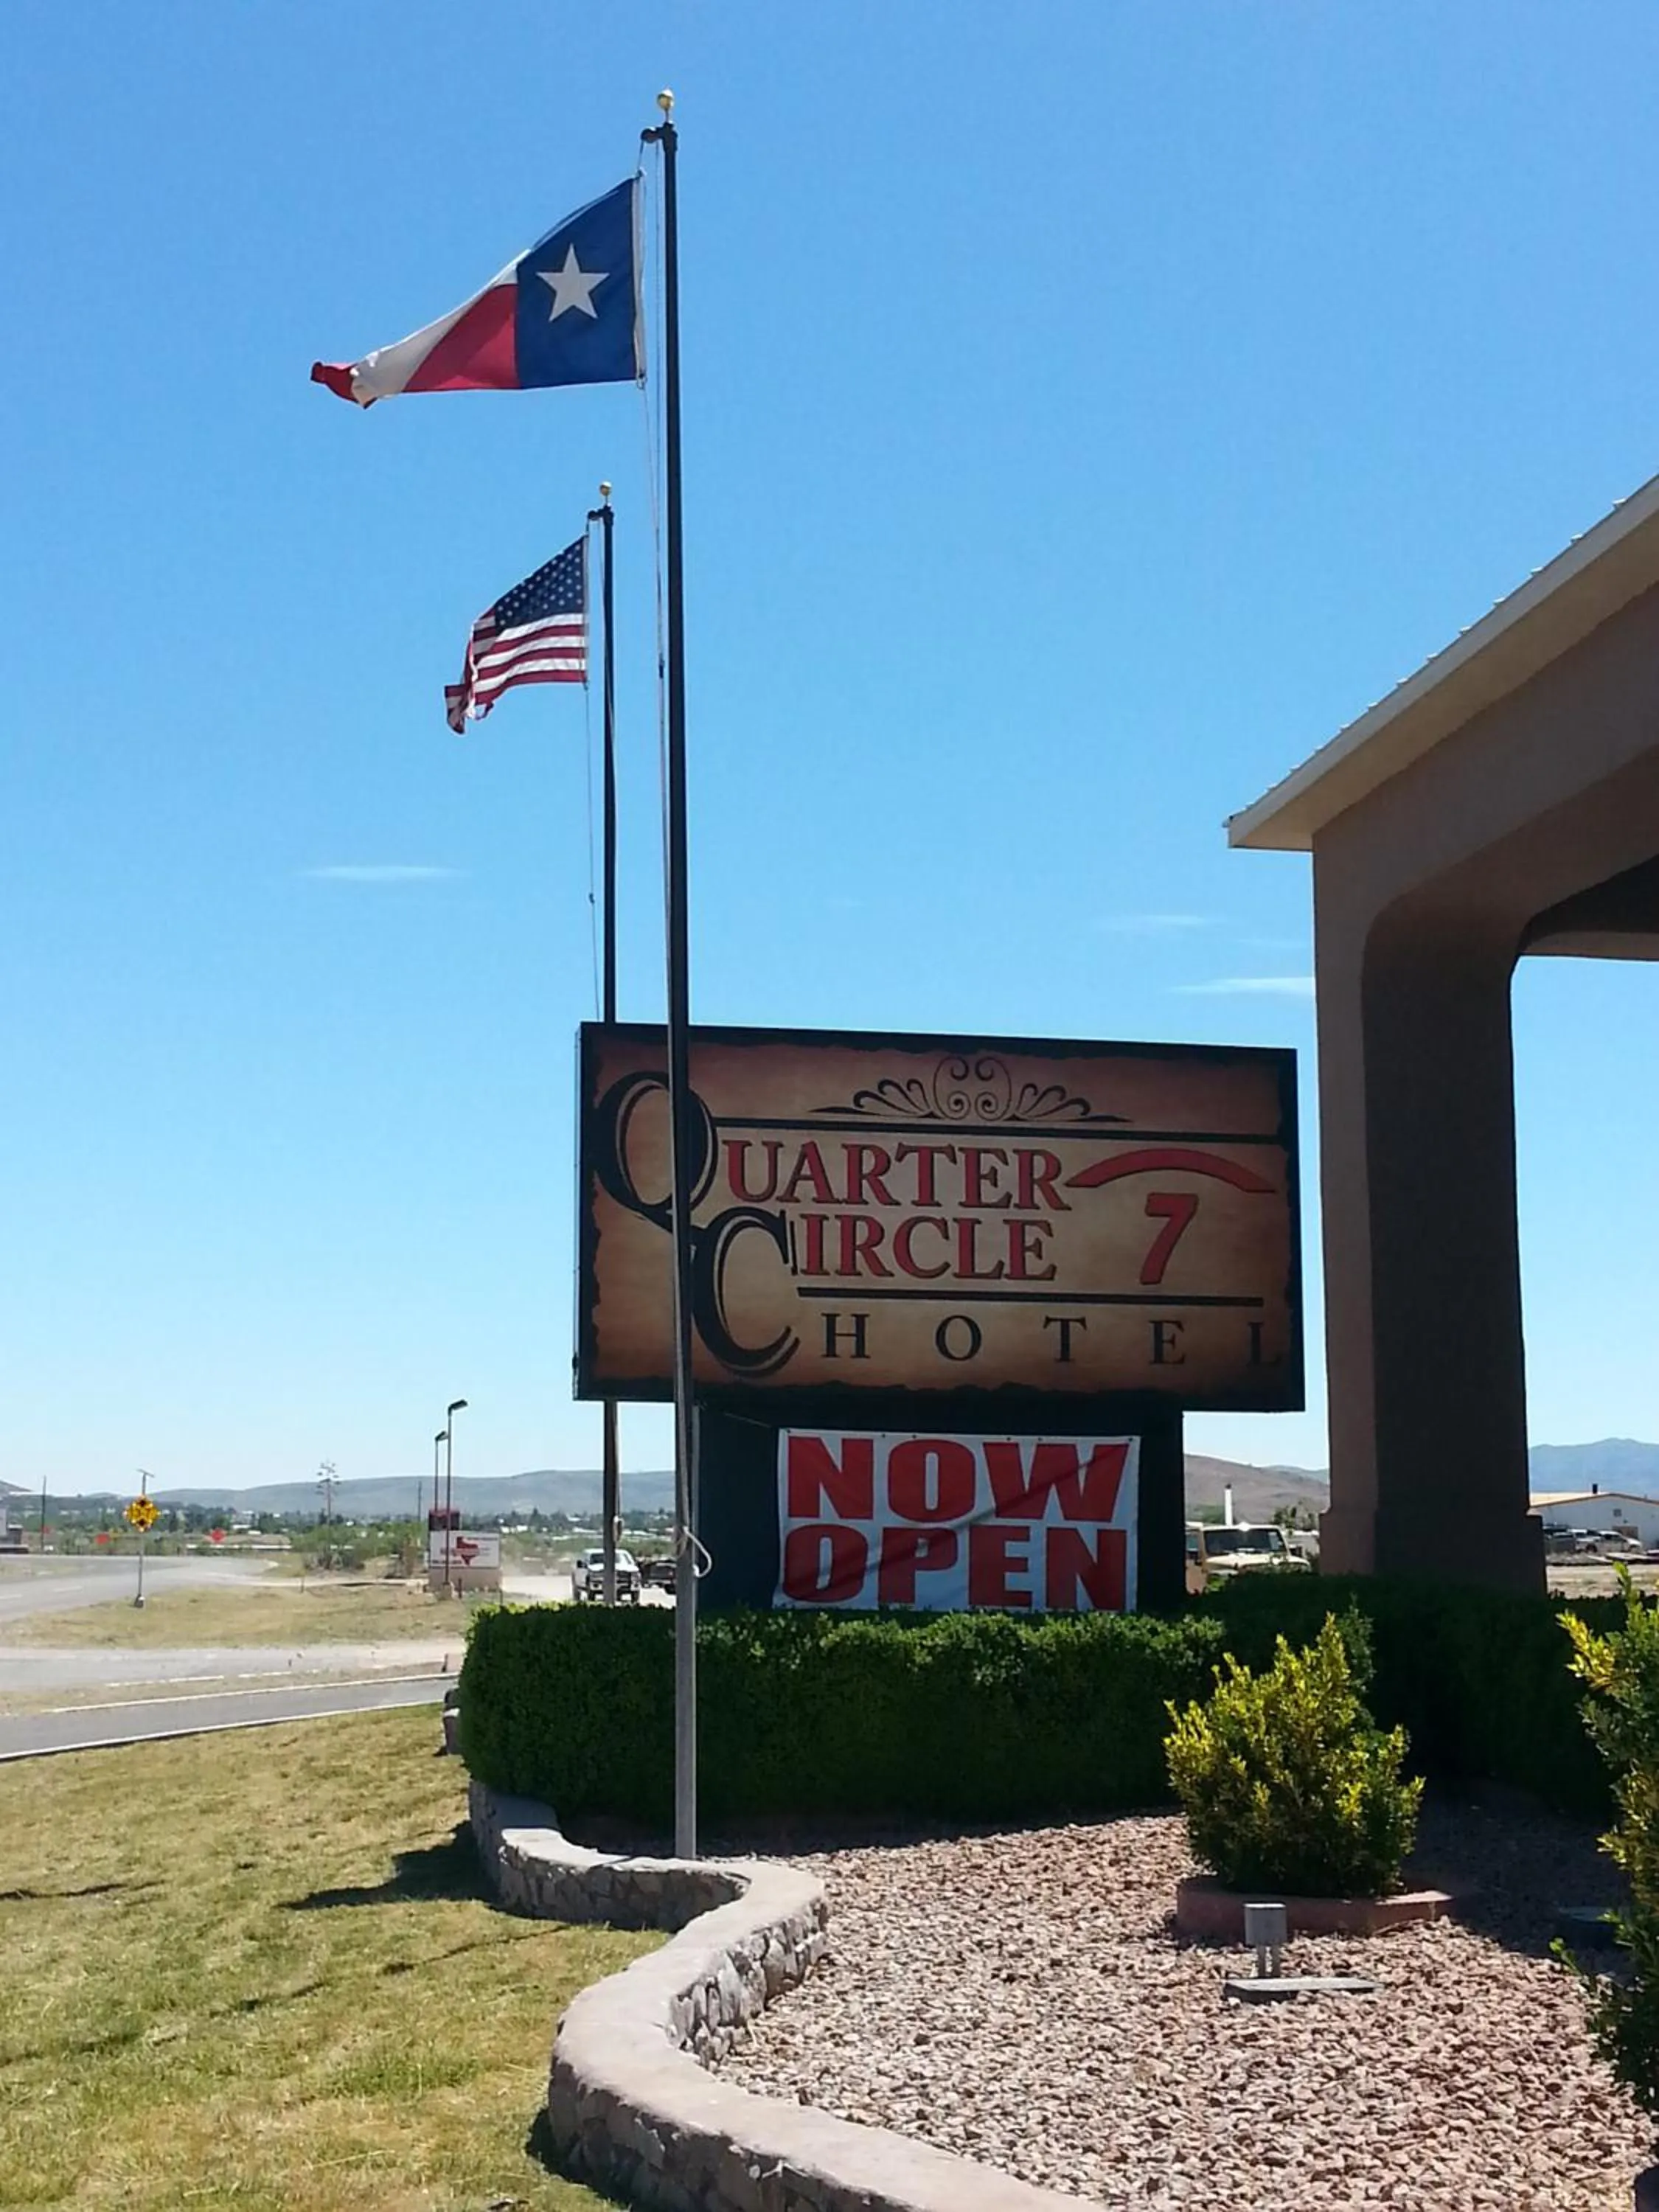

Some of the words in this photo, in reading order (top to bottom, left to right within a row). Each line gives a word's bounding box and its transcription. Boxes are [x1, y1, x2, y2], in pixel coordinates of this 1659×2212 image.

[594, 1071, 1071, 1234] QUARTER
[690, 1206, 1057, 1377] CIRCLE
[1140, 1192, 1200, 1284] 7
[821, 1312, 1281, 1366] HOTEL
[787, 1436, 1130, 1523] NOW
[783, 1524, 1127, 1610] OPEN
